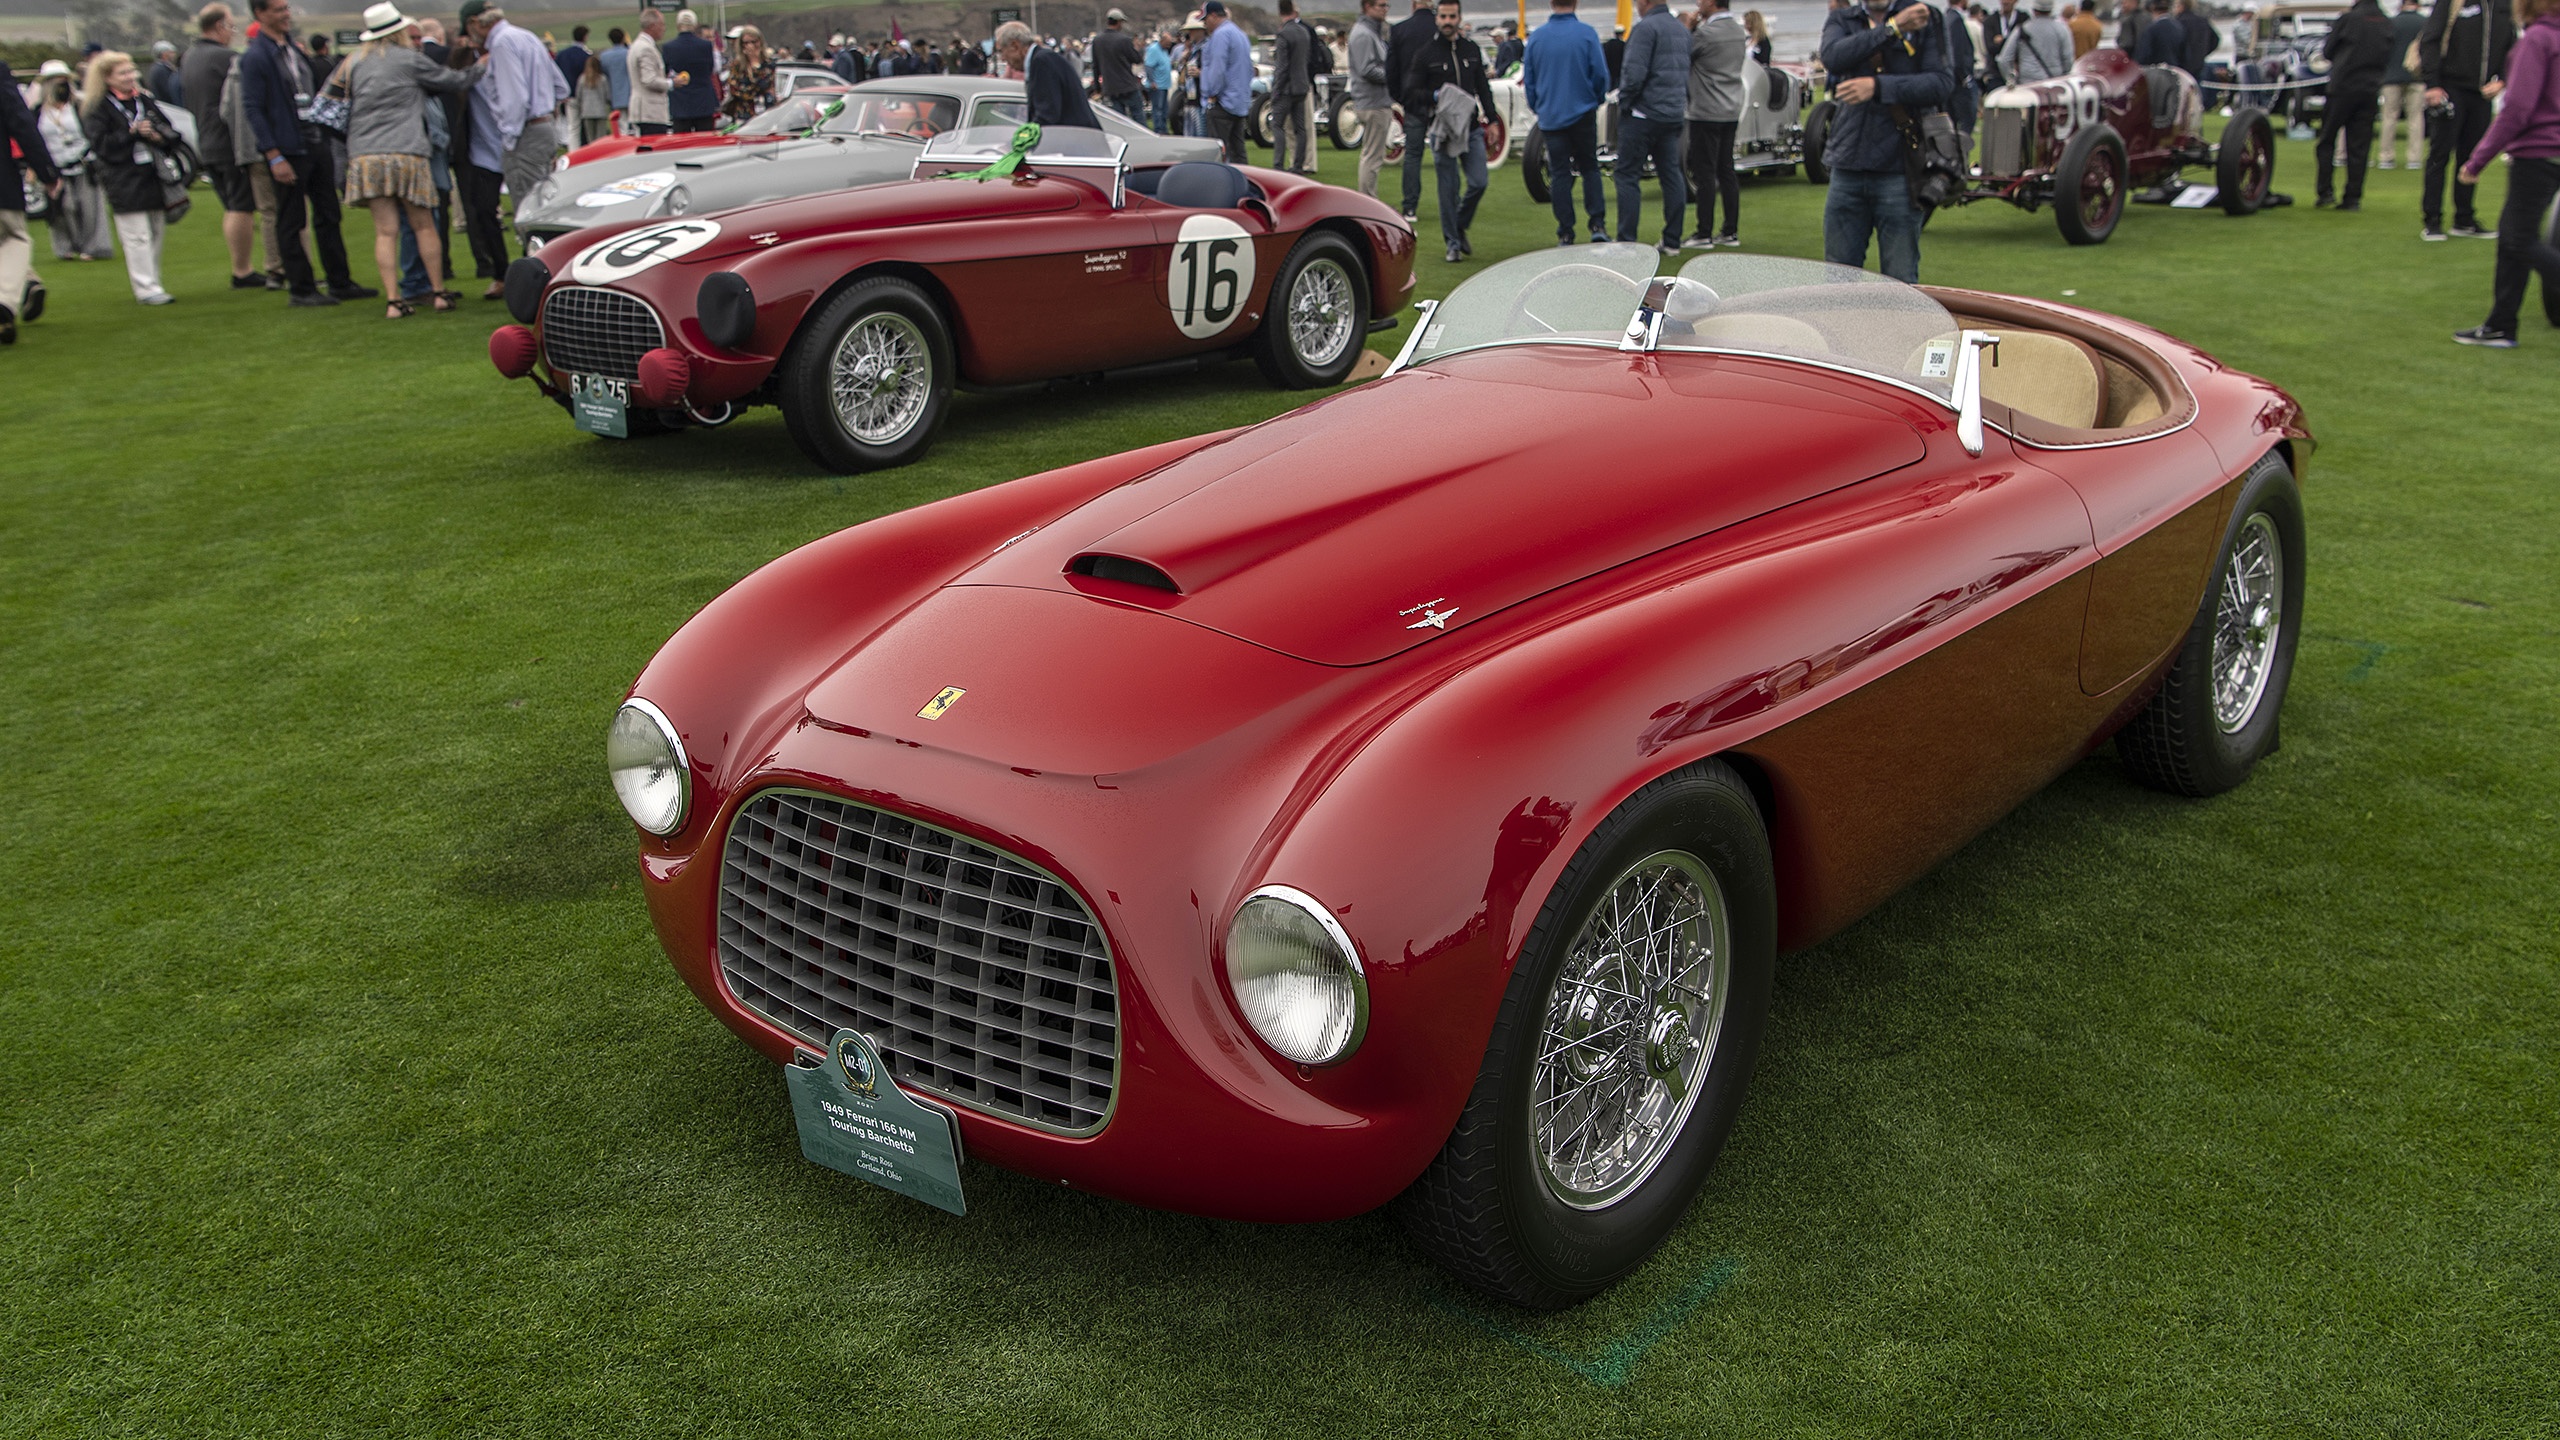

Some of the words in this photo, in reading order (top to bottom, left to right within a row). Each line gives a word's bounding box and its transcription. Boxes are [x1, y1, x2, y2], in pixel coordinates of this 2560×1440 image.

[581, 225, 706, 267] 16
[1180, 239, 1239, 327] 16
[821, 1100, 844, 1117] 1949
[846, 1108, 878, 1128] Ferrari
[880, 1120, 897, 1135] 166
[899, 1126, 917, 1142] MM
[828, 1116, 865, 1139] Touring
[867, 1129, 915, 1155] Barchetta
[861, 1150, 879, 1163] Brian
[879, 1156, 893, 1168] Ross
[886, 1169, 903, 1182] Ohio
